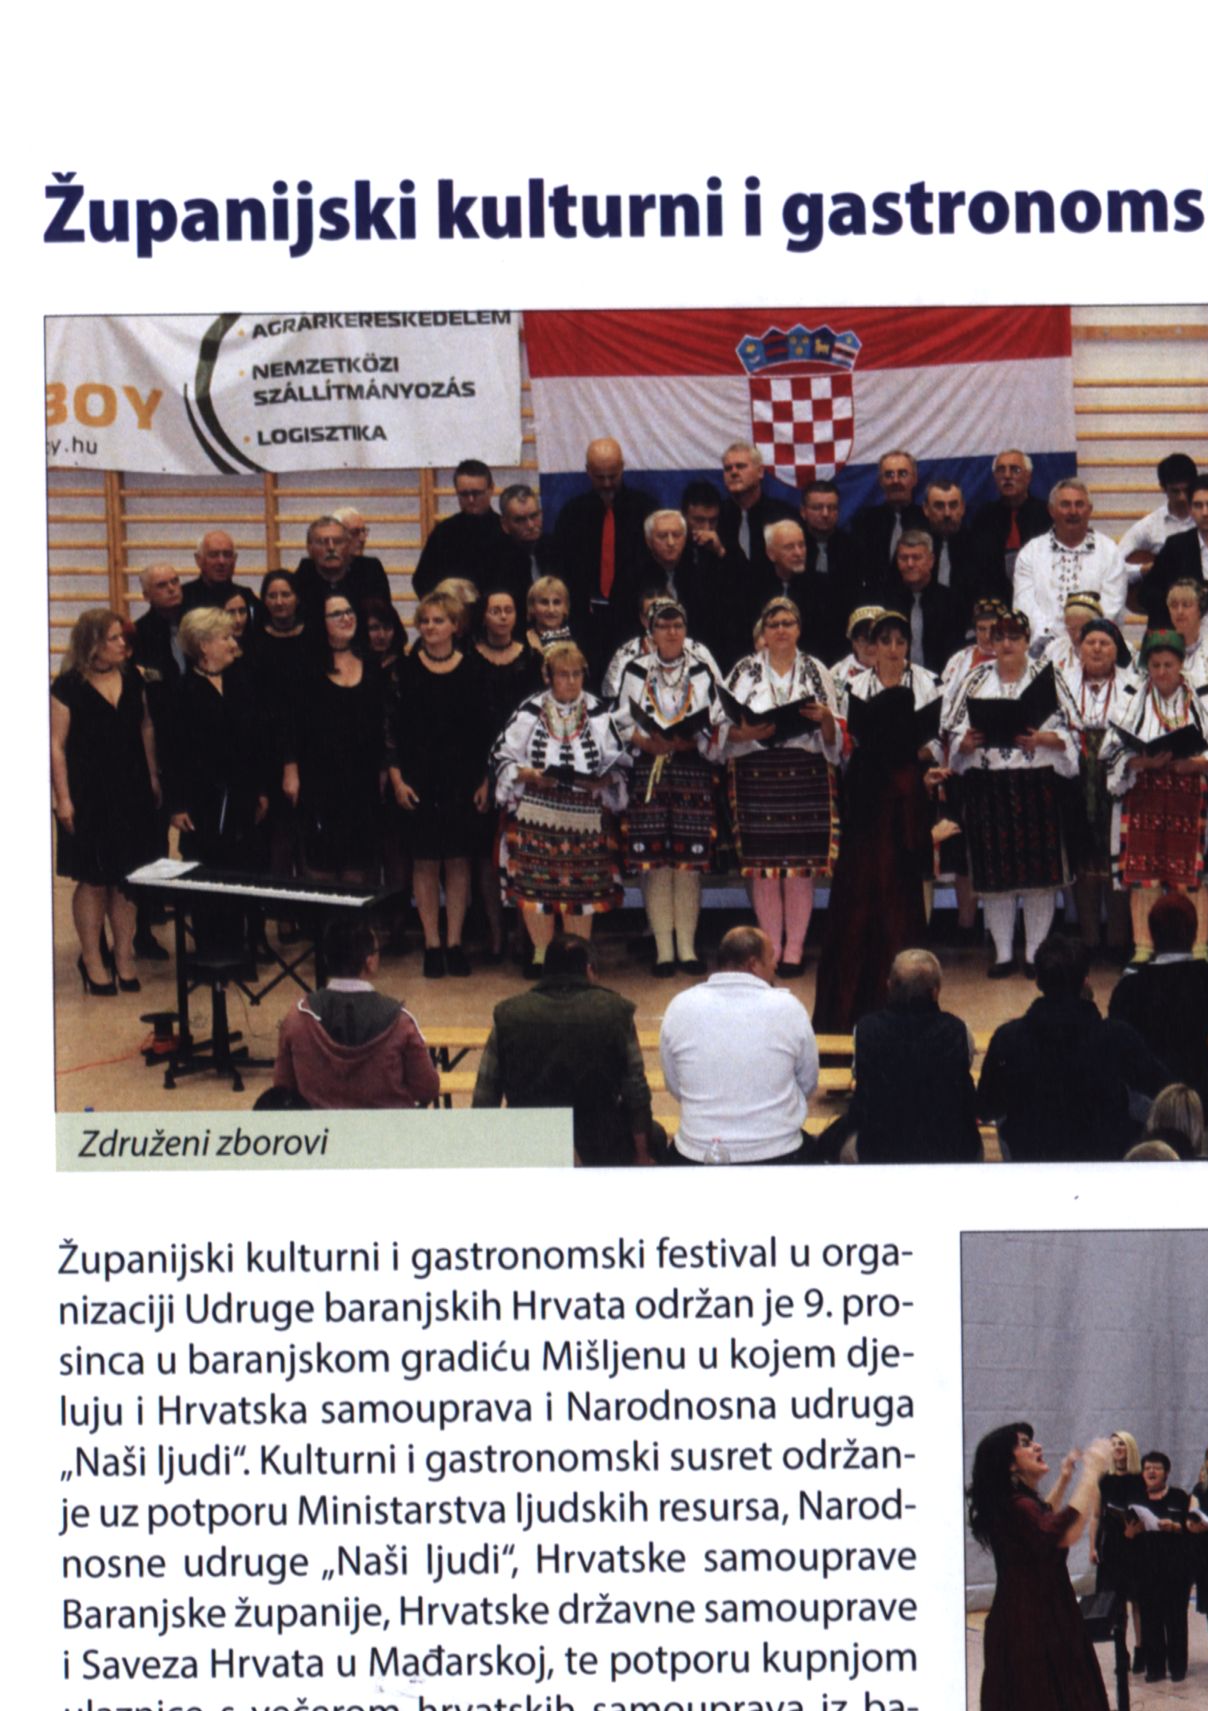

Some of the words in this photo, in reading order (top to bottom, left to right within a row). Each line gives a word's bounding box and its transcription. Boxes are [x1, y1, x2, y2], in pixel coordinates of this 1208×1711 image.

[43, 171, 417, 259] Županijski
[437, 176, 723, 240] kulturni
[744, 175, 762, 237] i
[252, 352, 399, 380] NEMZETKÖZI
[254, 376, 476, 406] SZÁLLÍTMÁNYOZÁS
[46, 435, 98, 457] y.hu
[257, 425, 387, 446] LOGISZTIKA
[78, 1128, 211, 1157] Združeni
[216, 1127, 329, 1156] zborovi
[58, 1238, 233, 1282] Županijski
[247, 1240, 379, 1273] kulturni
[392, 1241, 399, 1271] i
[411, 1237, 645, 1280] gastronomski
[656, 1235, 776, 1269] festival
[790, 1244, 810, 1268] u
[822, 1243, 913, 1275] orga-
[59, 1294, 174, 1333] nizaciji
[186, 1291, 315, 1332] Udruge
[325, 1289, 501, 1330] baranjskih
[513, 1290, 625, 1321] Hrvata
[635, 1287, 754, 1320] održan
[761, 1288, 794, 1327] je
[804, 1288, 833, 1318] 9.
[843, 1294, 914, 1326] pro-
[59, 1345, 144, 1376] sinca
[157, 1352, 176, 1375] u
[188, 1341, 390, 1382] baranjskom
[401, 1340, 530, 1381] gradiću
[542, 1338, 686, 1379] Mišljenu
[698, 1347, 718, 1370] u
[730, 1337, 836, 1377] kojem
[847, 1336, 914, 1376] dje-
[60, 1395, 123, 1435] luju
[137, 1395, 143, 1426] i
[158, 1392, 307, 1425] Hrvatska
[321, 1399, 532, 1431] samouprava
[546, 1391, 552, 1422] i
[567, 1388, 776, 1421] Narodnosna
[791, 1387, 914, 1427] udruga
